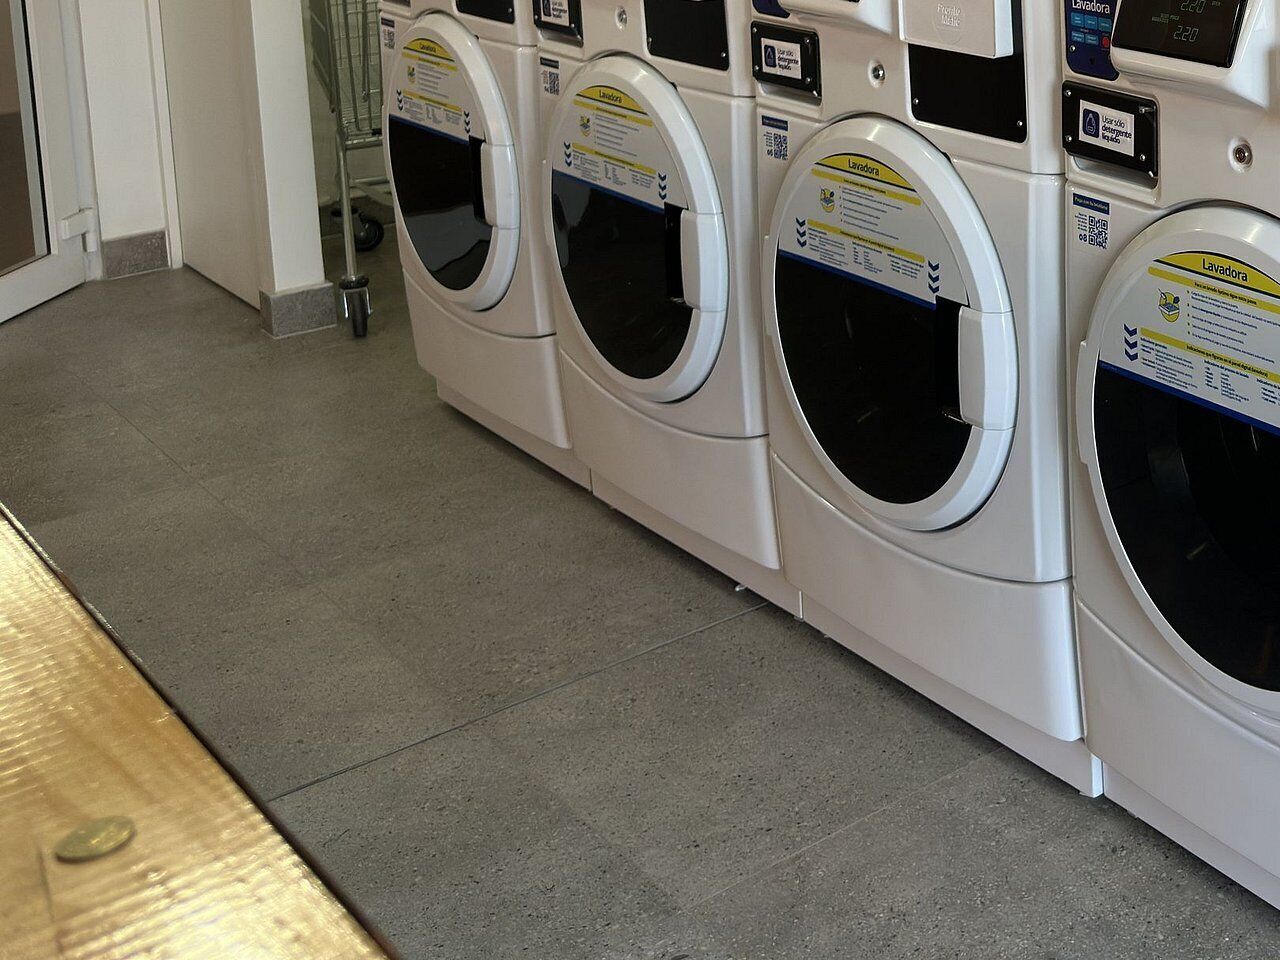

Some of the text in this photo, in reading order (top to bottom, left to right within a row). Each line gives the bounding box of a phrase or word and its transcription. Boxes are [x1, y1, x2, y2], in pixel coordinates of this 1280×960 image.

[1174, 26, 1198, 42] 2.20
[1102, 115, 1125, 128] Usar sólo
[1102, 124, 1132, 140] detergente
[1102, 133, 1121, 144] líquido
[848, 158, 880, 176] Lavadora
[1202, 258, 1248, 282] Lavadora
